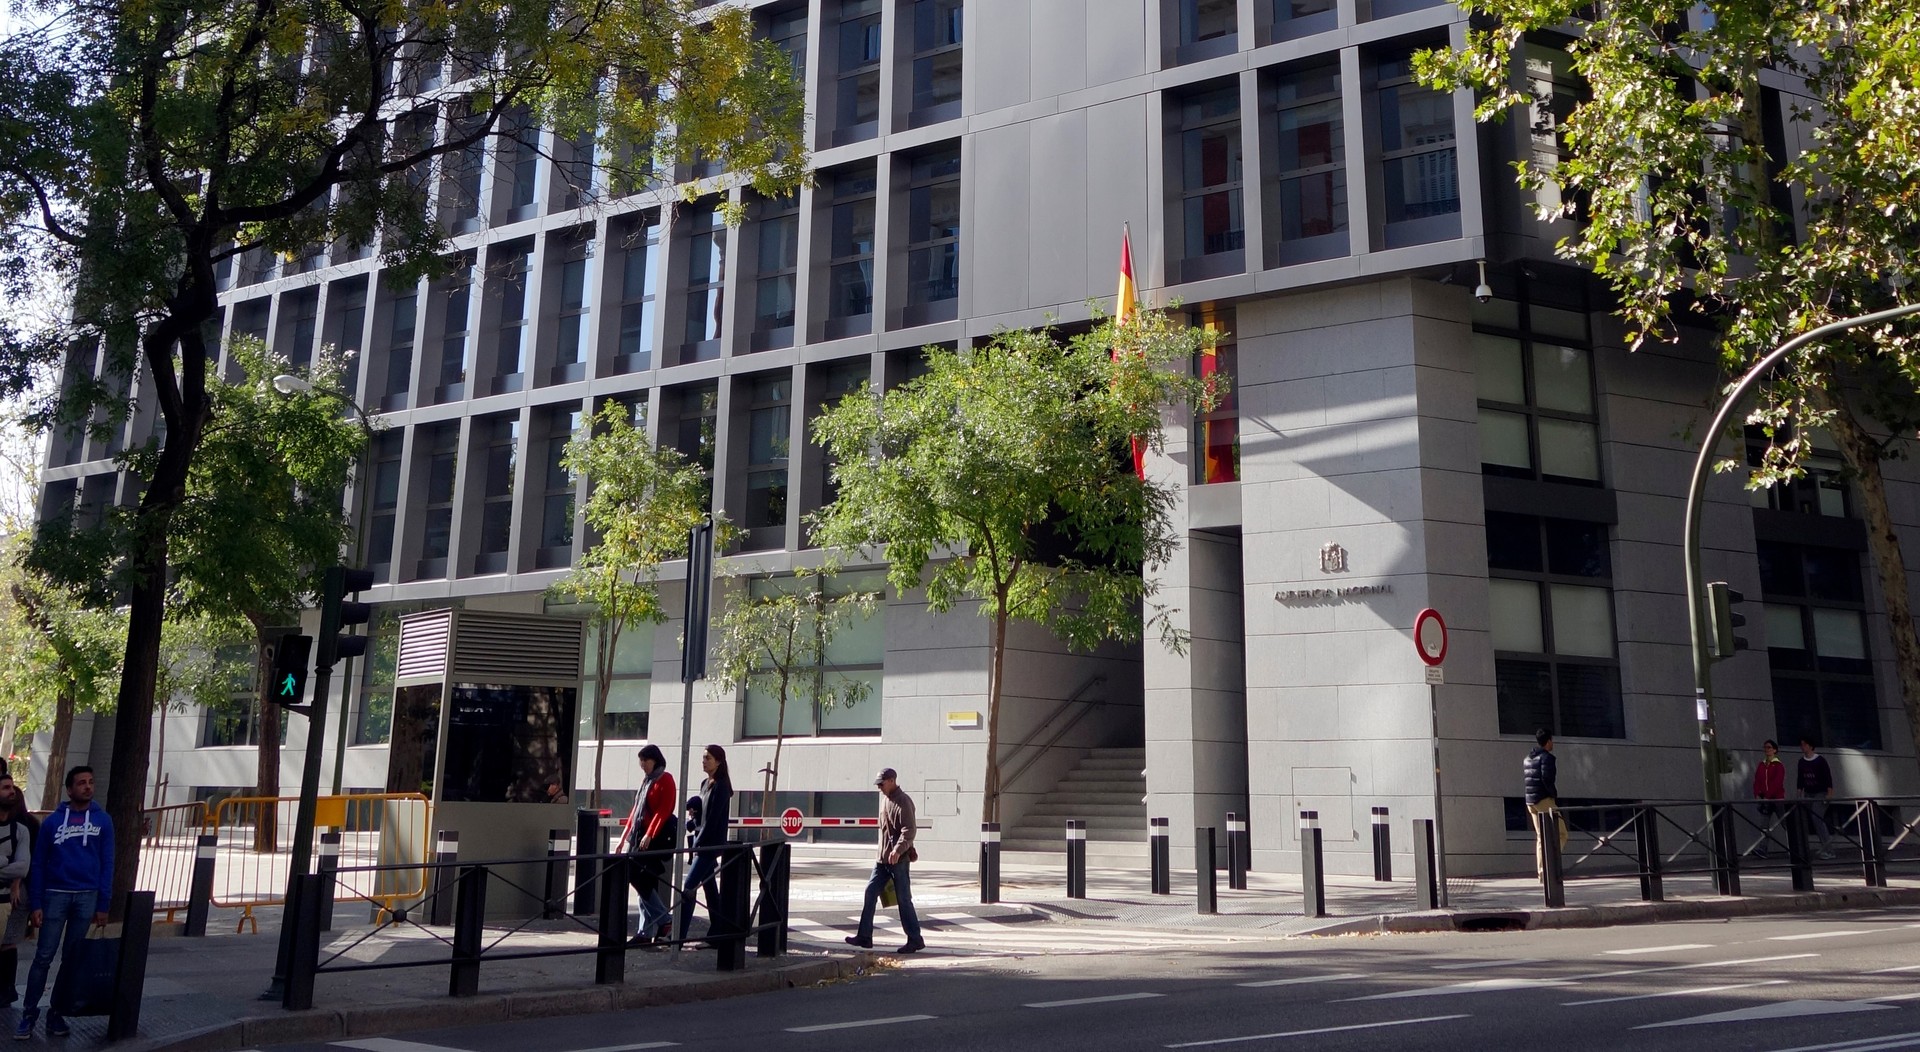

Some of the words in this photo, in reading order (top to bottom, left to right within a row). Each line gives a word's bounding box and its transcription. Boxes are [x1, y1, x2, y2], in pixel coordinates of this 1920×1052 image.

[1274, 588, 1334, 600] AUDIENCIA
[1336, 584, 1394, 598] NACIONAL
[782, 816, 802, 828] STOP
